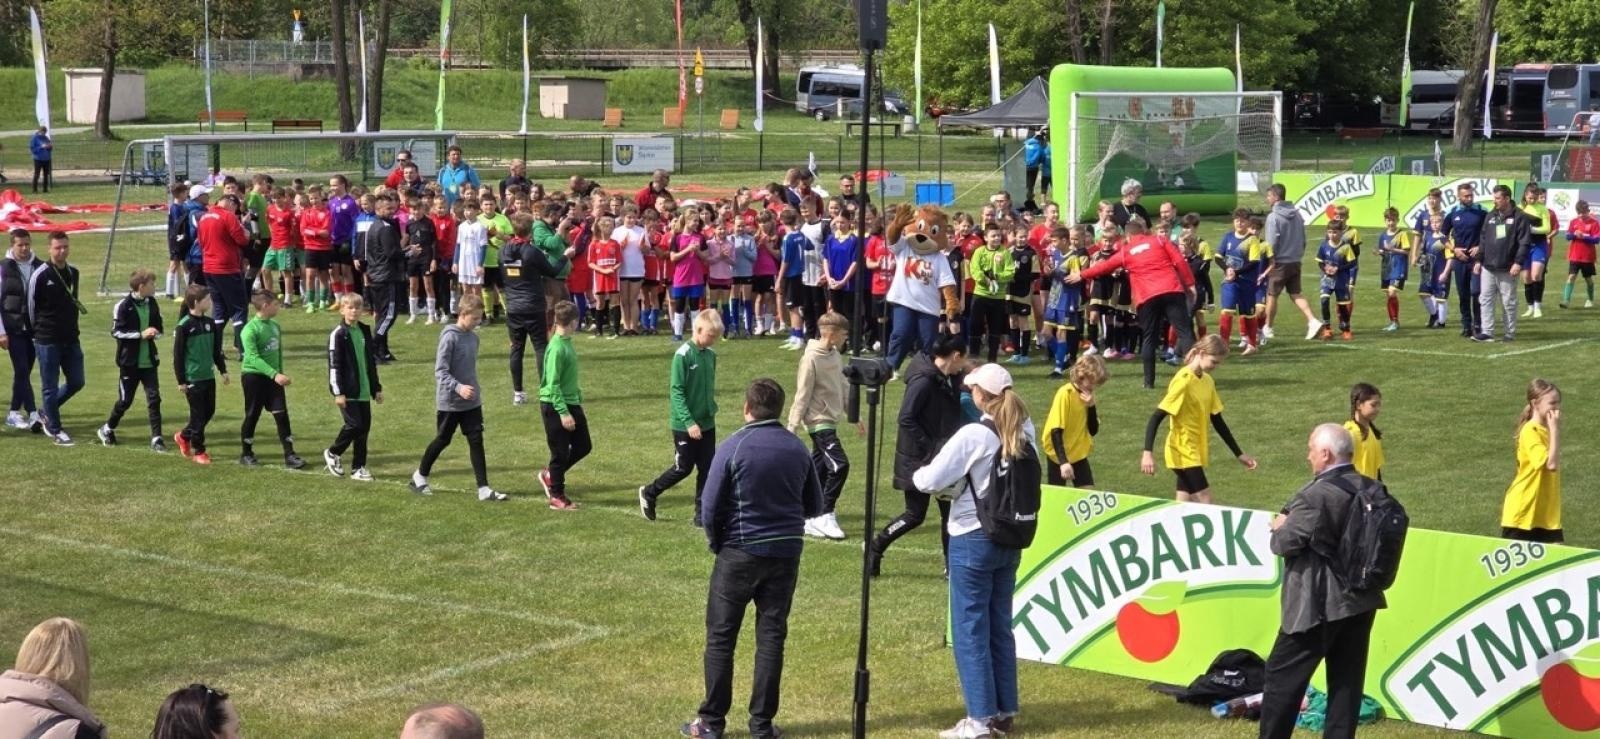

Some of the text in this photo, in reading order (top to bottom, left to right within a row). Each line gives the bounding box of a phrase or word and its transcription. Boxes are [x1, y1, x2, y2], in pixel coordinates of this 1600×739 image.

[1299, 174, 1369, 217] YMBARK
[1067, 491, 1117, 525] 1936
[1481, 541, 1545, 577] 1936
[1012, 510, 1263, 655] TYMBARK
